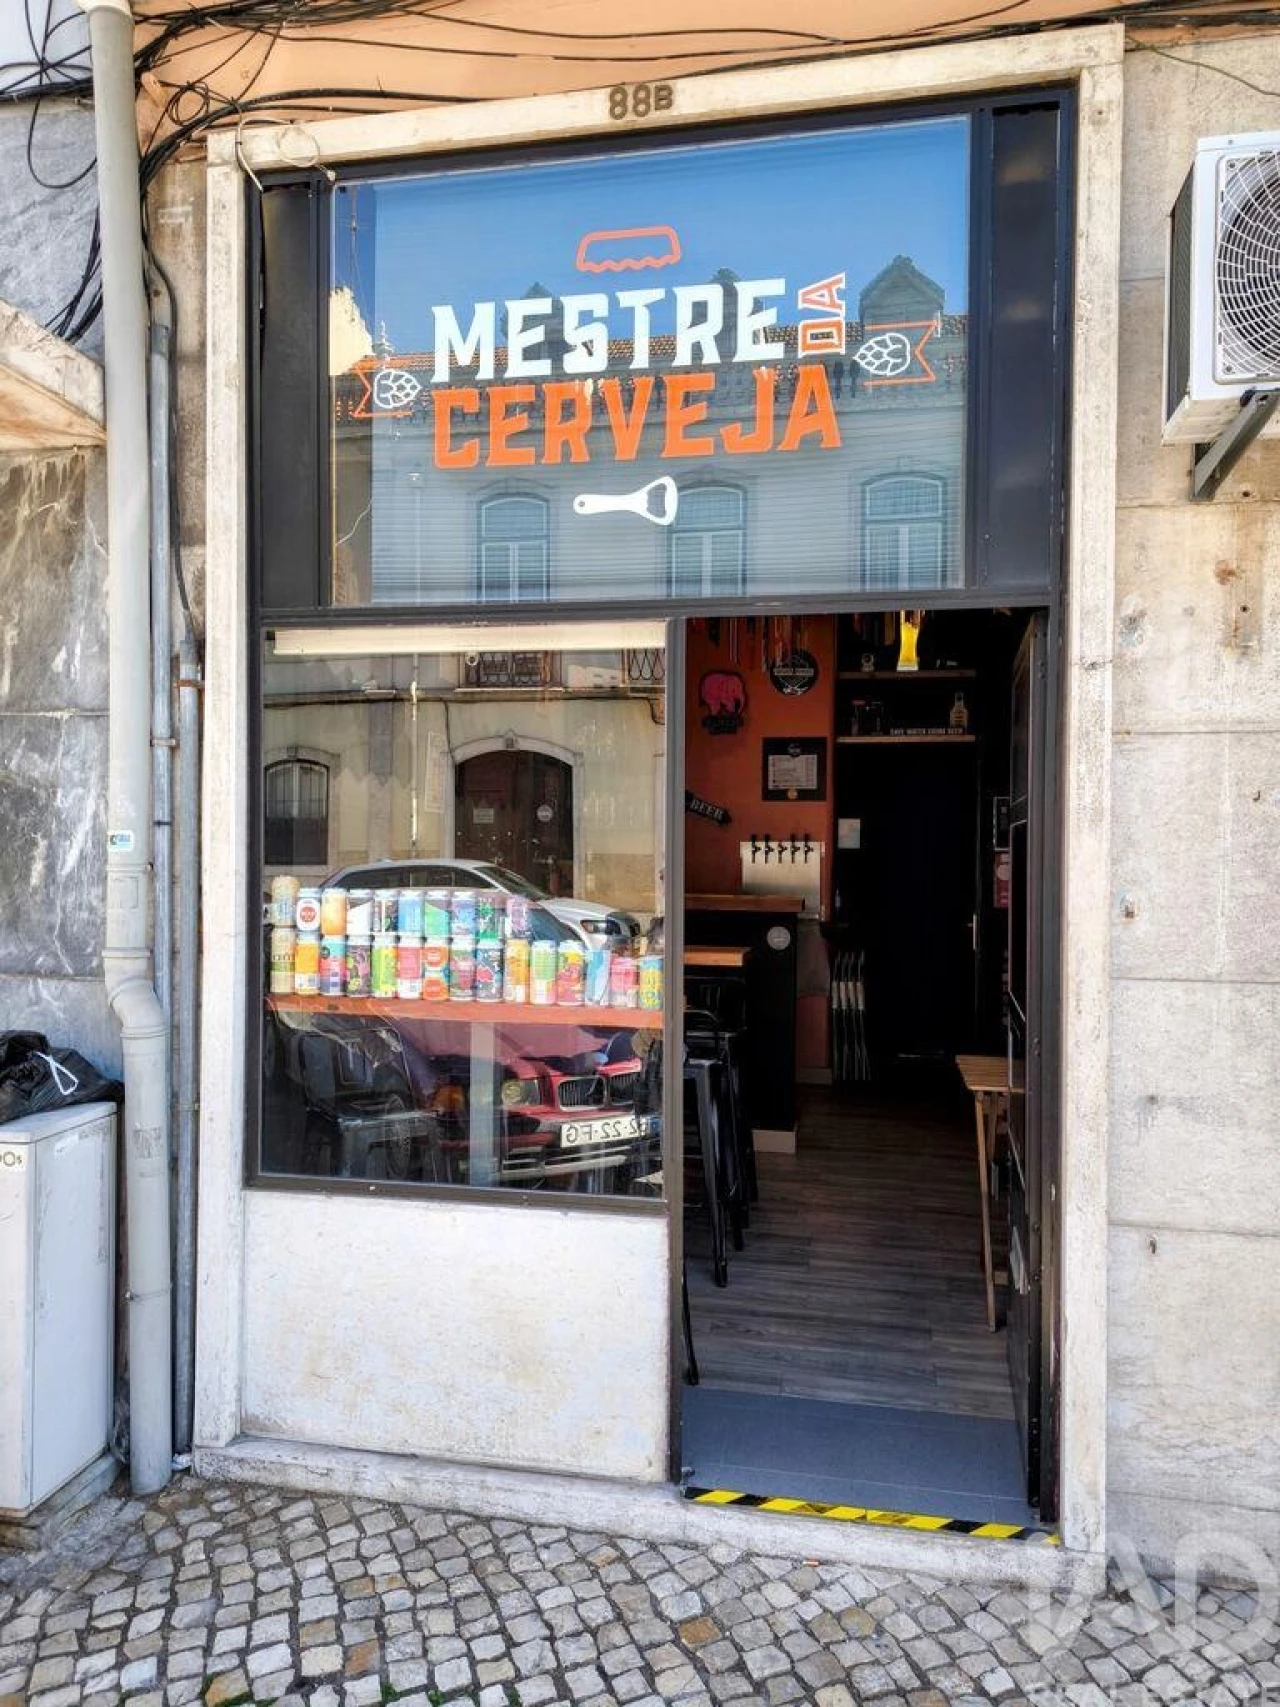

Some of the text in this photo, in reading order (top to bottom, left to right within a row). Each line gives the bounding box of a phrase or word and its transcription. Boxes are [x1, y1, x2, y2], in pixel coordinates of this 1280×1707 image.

[610, 84, 673, 120] 88B
[431, 272, 846, 383] MESTRE DA
[431, 364, 842, 469] CERVEJA
[690, 798, 724, 821] BEER
